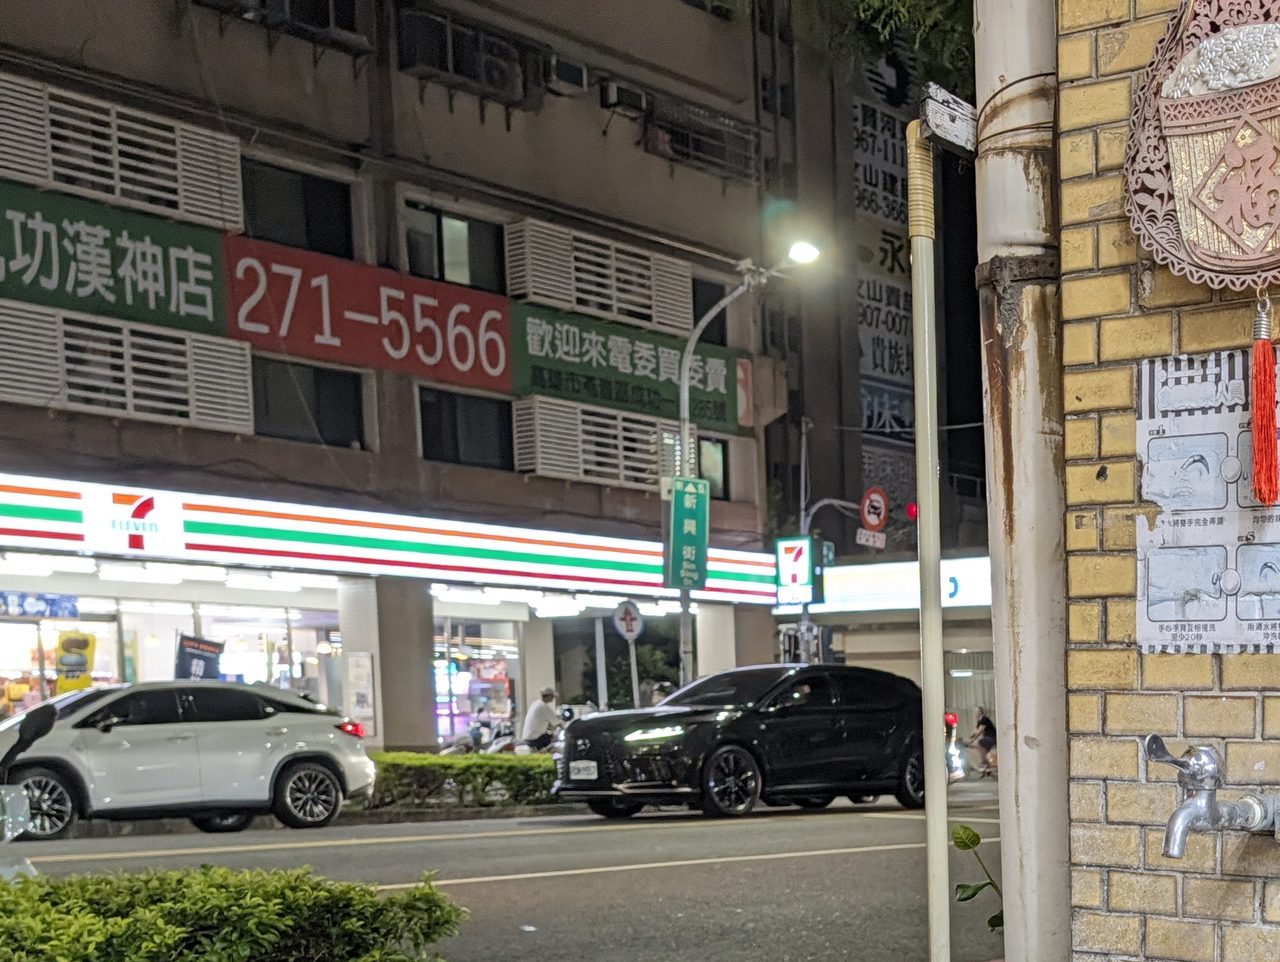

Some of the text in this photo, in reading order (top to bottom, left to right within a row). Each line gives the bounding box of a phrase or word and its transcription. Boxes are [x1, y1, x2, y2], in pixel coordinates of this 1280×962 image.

[0, 210, 214, 321] 功漢神店
[236, 257, 506, 377] 271-5566
